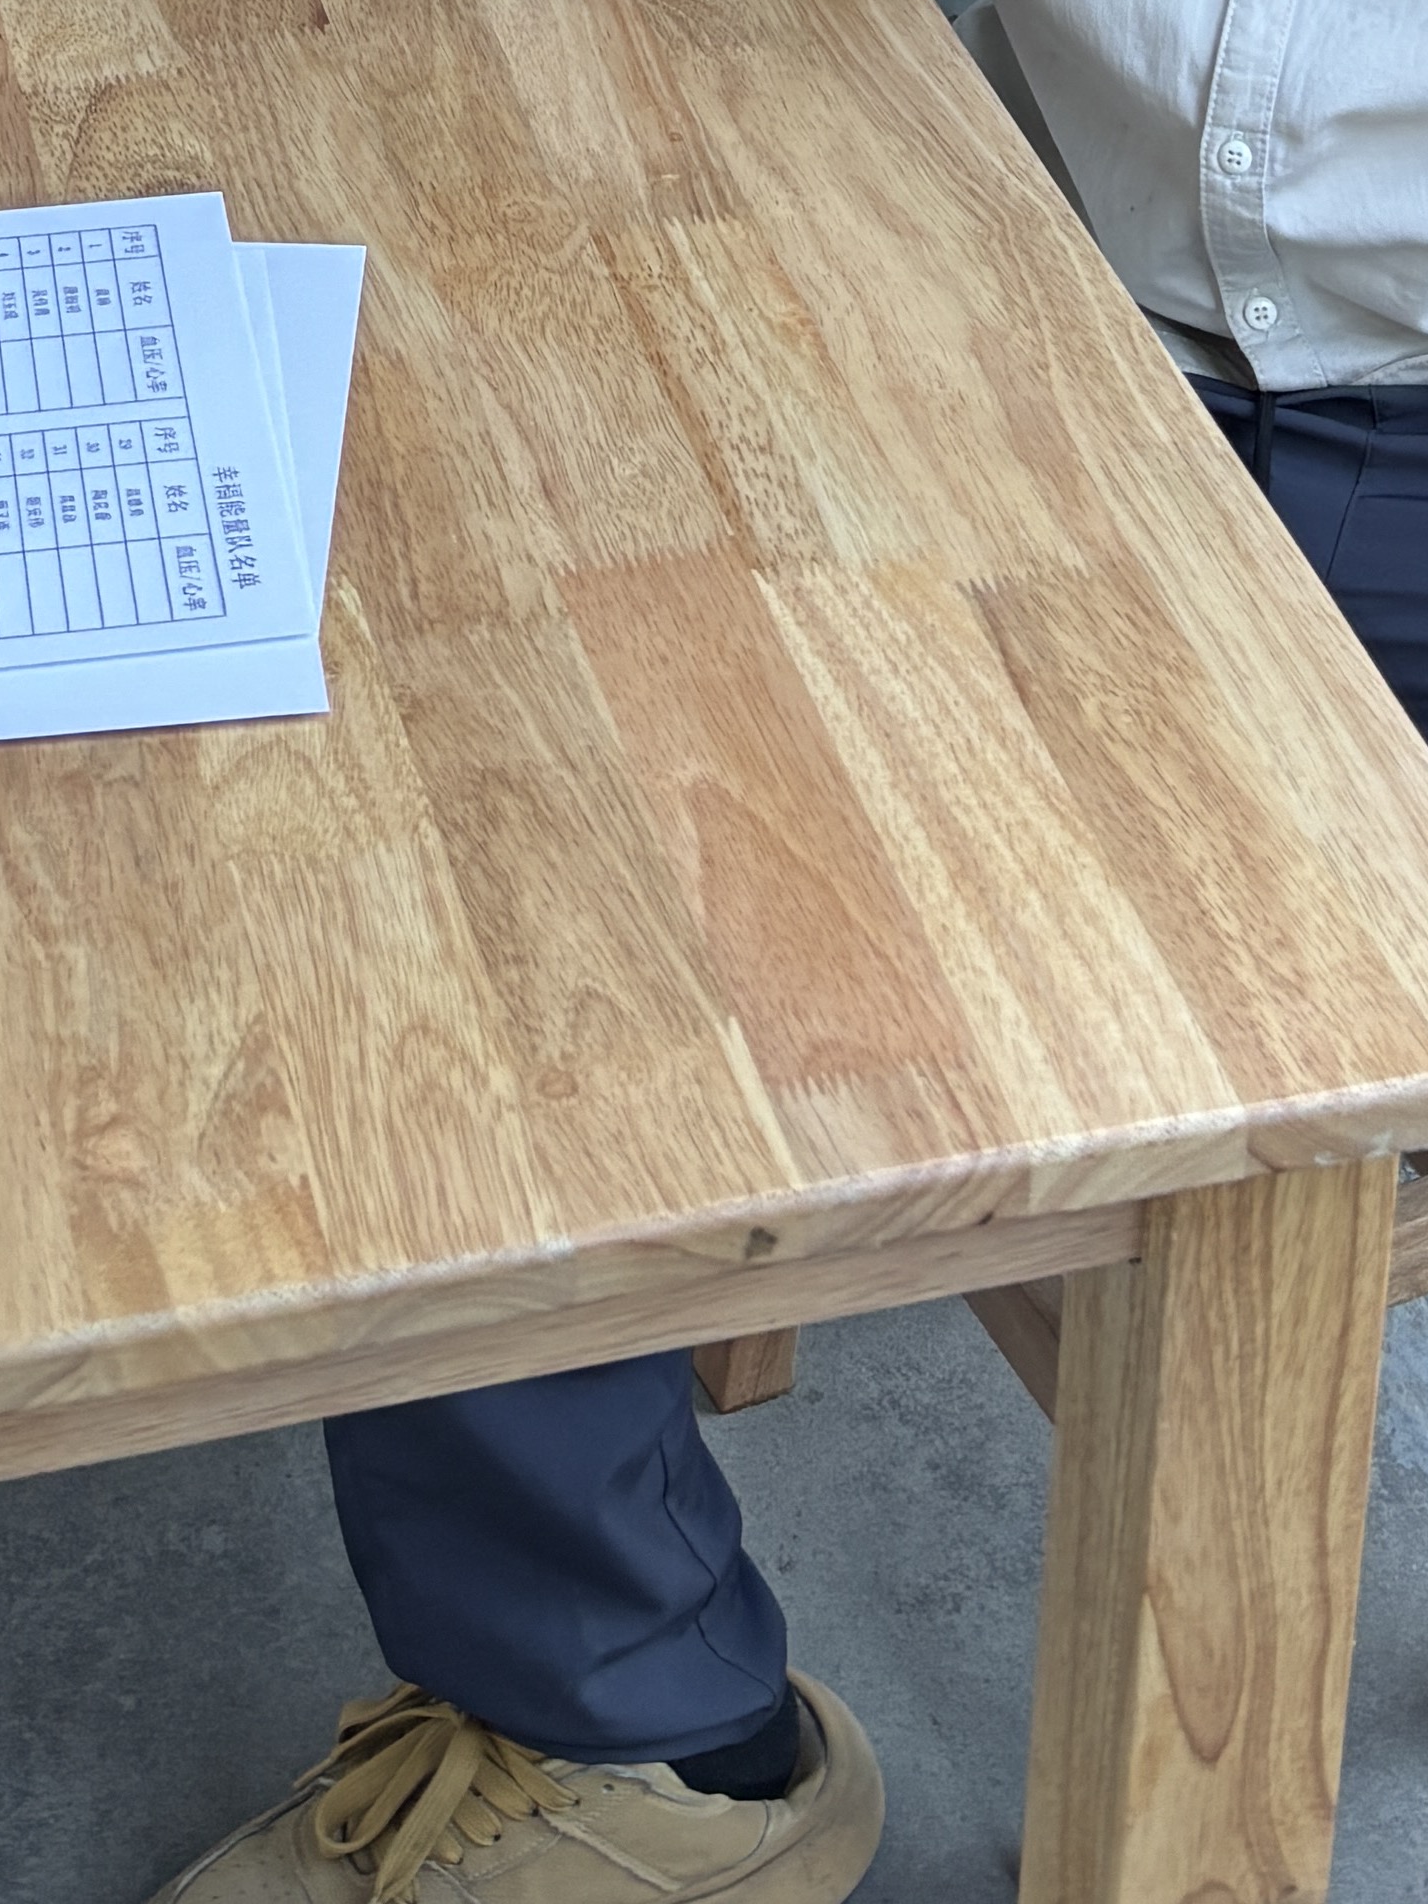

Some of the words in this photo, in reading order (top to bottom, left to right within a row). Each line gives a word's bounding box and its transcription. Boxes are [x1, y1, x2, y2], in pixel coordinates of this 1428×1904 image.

[120, 230, 145, 254] 序号
[128, 280, 153, 306] 姓名
[153, 426, 180, 454] 序号
[162, 484, 189, 513] 姓名
[212, 466, 260, 589] 幸福能量队名单
